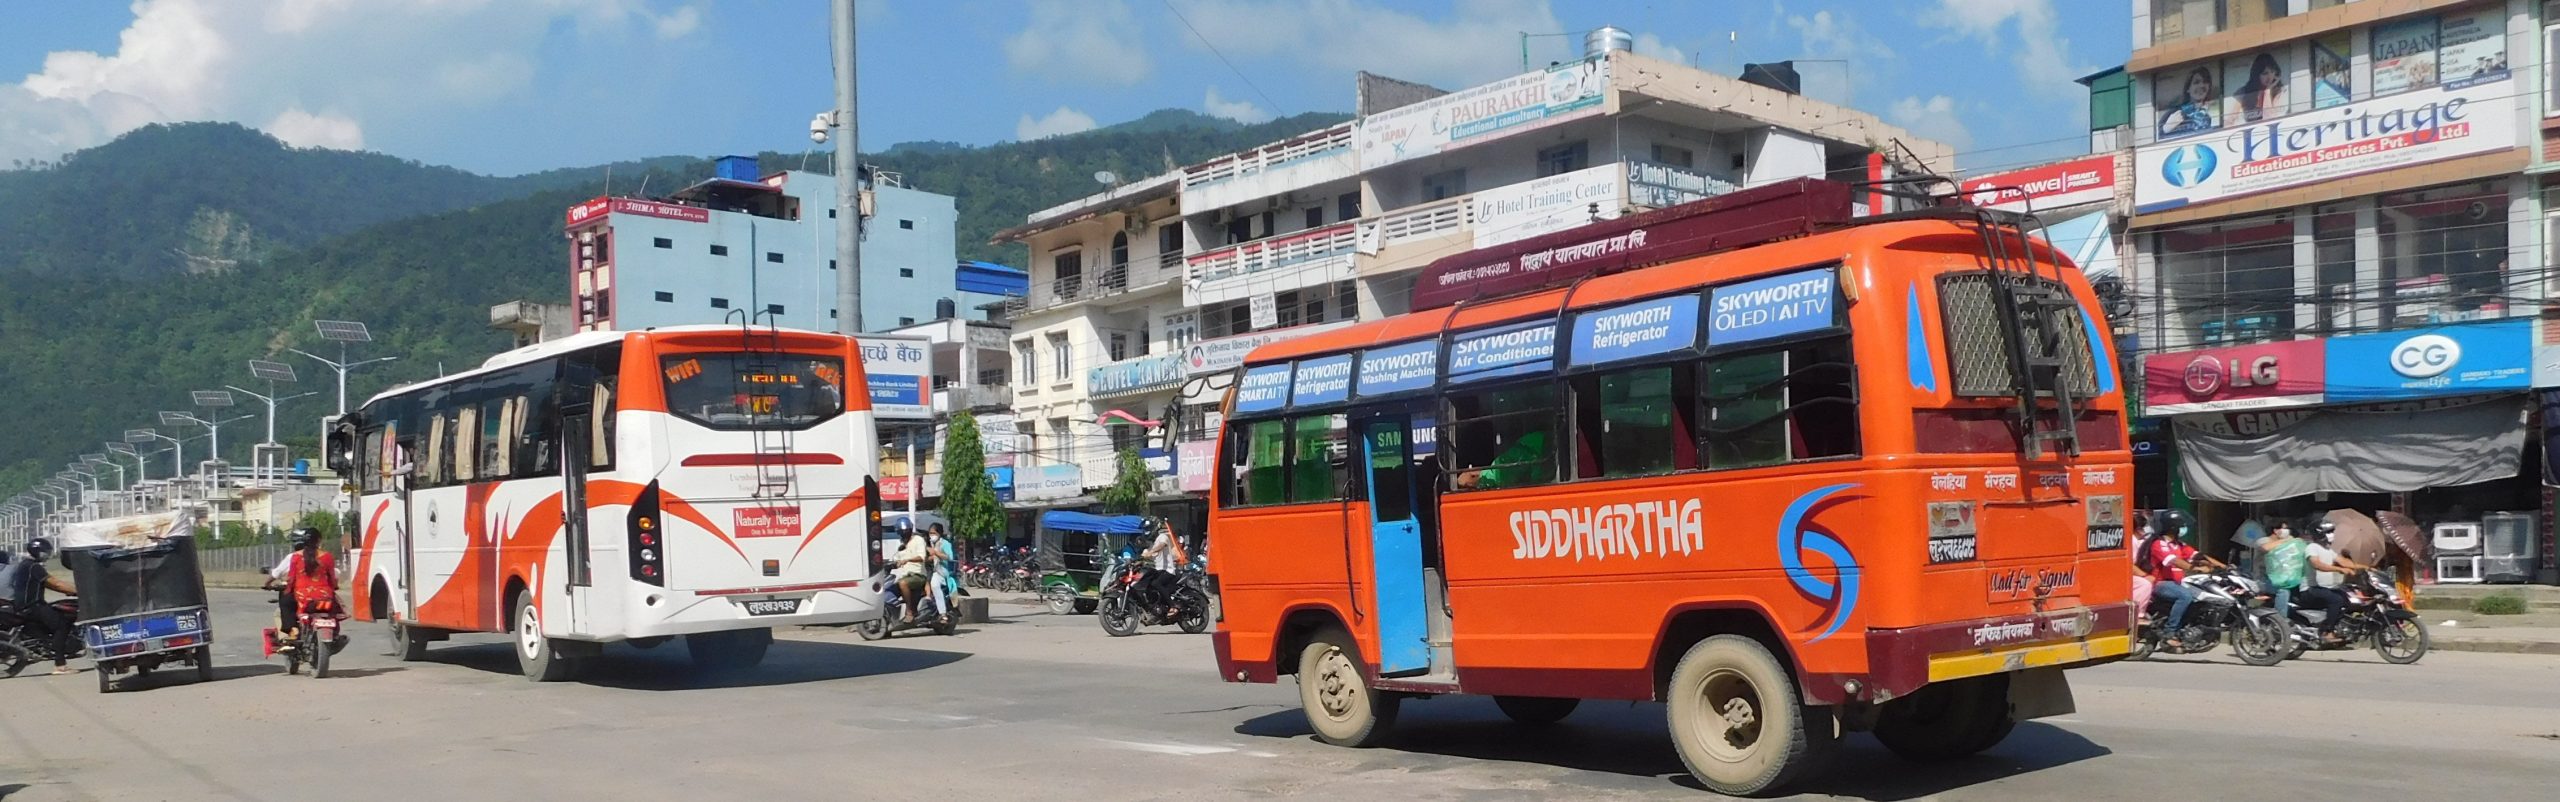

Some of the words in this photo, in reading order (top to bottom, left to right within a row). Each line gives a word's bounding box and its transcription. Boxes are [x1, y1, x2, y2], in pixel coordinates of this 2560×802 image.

[2376, 34, 2435, 60] JAPAN
[1451, 84, 1546, 124] PAURAKHI
[1453, 117, 1498, 138] Educational
[2227, 97, 2467, 163] Heritage
[2233, 151, 2312, 177] Educational
[2316, 142, 2376, 163] Services
[2380, 136, 2408, 151] Pvt.
[2438, 124, 2469, 139] Ltd.
[1641, 162, 1666, 184] Hotel
[1667, 168, 1705, 194] Training
[1705, 175, 1734, 195] Center
[2067, 171, 2097, 180] SMART
[2067, 177, 2100, 188] PHONES
[1497, 196, 1524, 215] Hotel
[1526, 188, 1572, 209] Training
[1575, 182, 1613, 199] Center
[2001, 178, 2061, 198] HUAWEI
[572, 205, 588, 221] OYO
[1717, 277, 1828, 312] SKYWORTH
[1594, 305, 1672, 334] SKYWORTH
[1715, 309, 1768, 331] OLED
[1779, 304, 1798, 321] AI
[1803, 297, 1827, 316] TV
[1457, 325, 1556, 354] SKYWORTH
[1592, 324, 1669, 349] Refrigerator
[895, 343, 922, 362] बैंक
[1361, 350, 1437, 375] SKYWORTH
[1454, 352, 1473, 369] Air
[2398, 344, 2448, 368] CG
[1241, 370, 1289, 389] SKYWORTH
[1297, 361, 1351, 381] SKYWORTH
[1361, 372, 1398, 385] Washing
[2229, 355, 2280, 388] LG
[1239, 387, 1266, 402] SMART
[1266, 386, 1276, 399] AI
[1277, 385, 1287, 398] TV
[1295, 378, 1348, 395] Refrigerator
[2235, 399, 2267, 407] TRADERS
[1045, 479, 1080, 489] Computer
[735, 510, 772, 528] Naturally
[775, 509, 799, 527] Nepal
[1510, 498, 1703, 562] SIDDHARTHA
[1990, 569, 2016, 593] Wait
[2038, 565, 2077, 596] Signal
